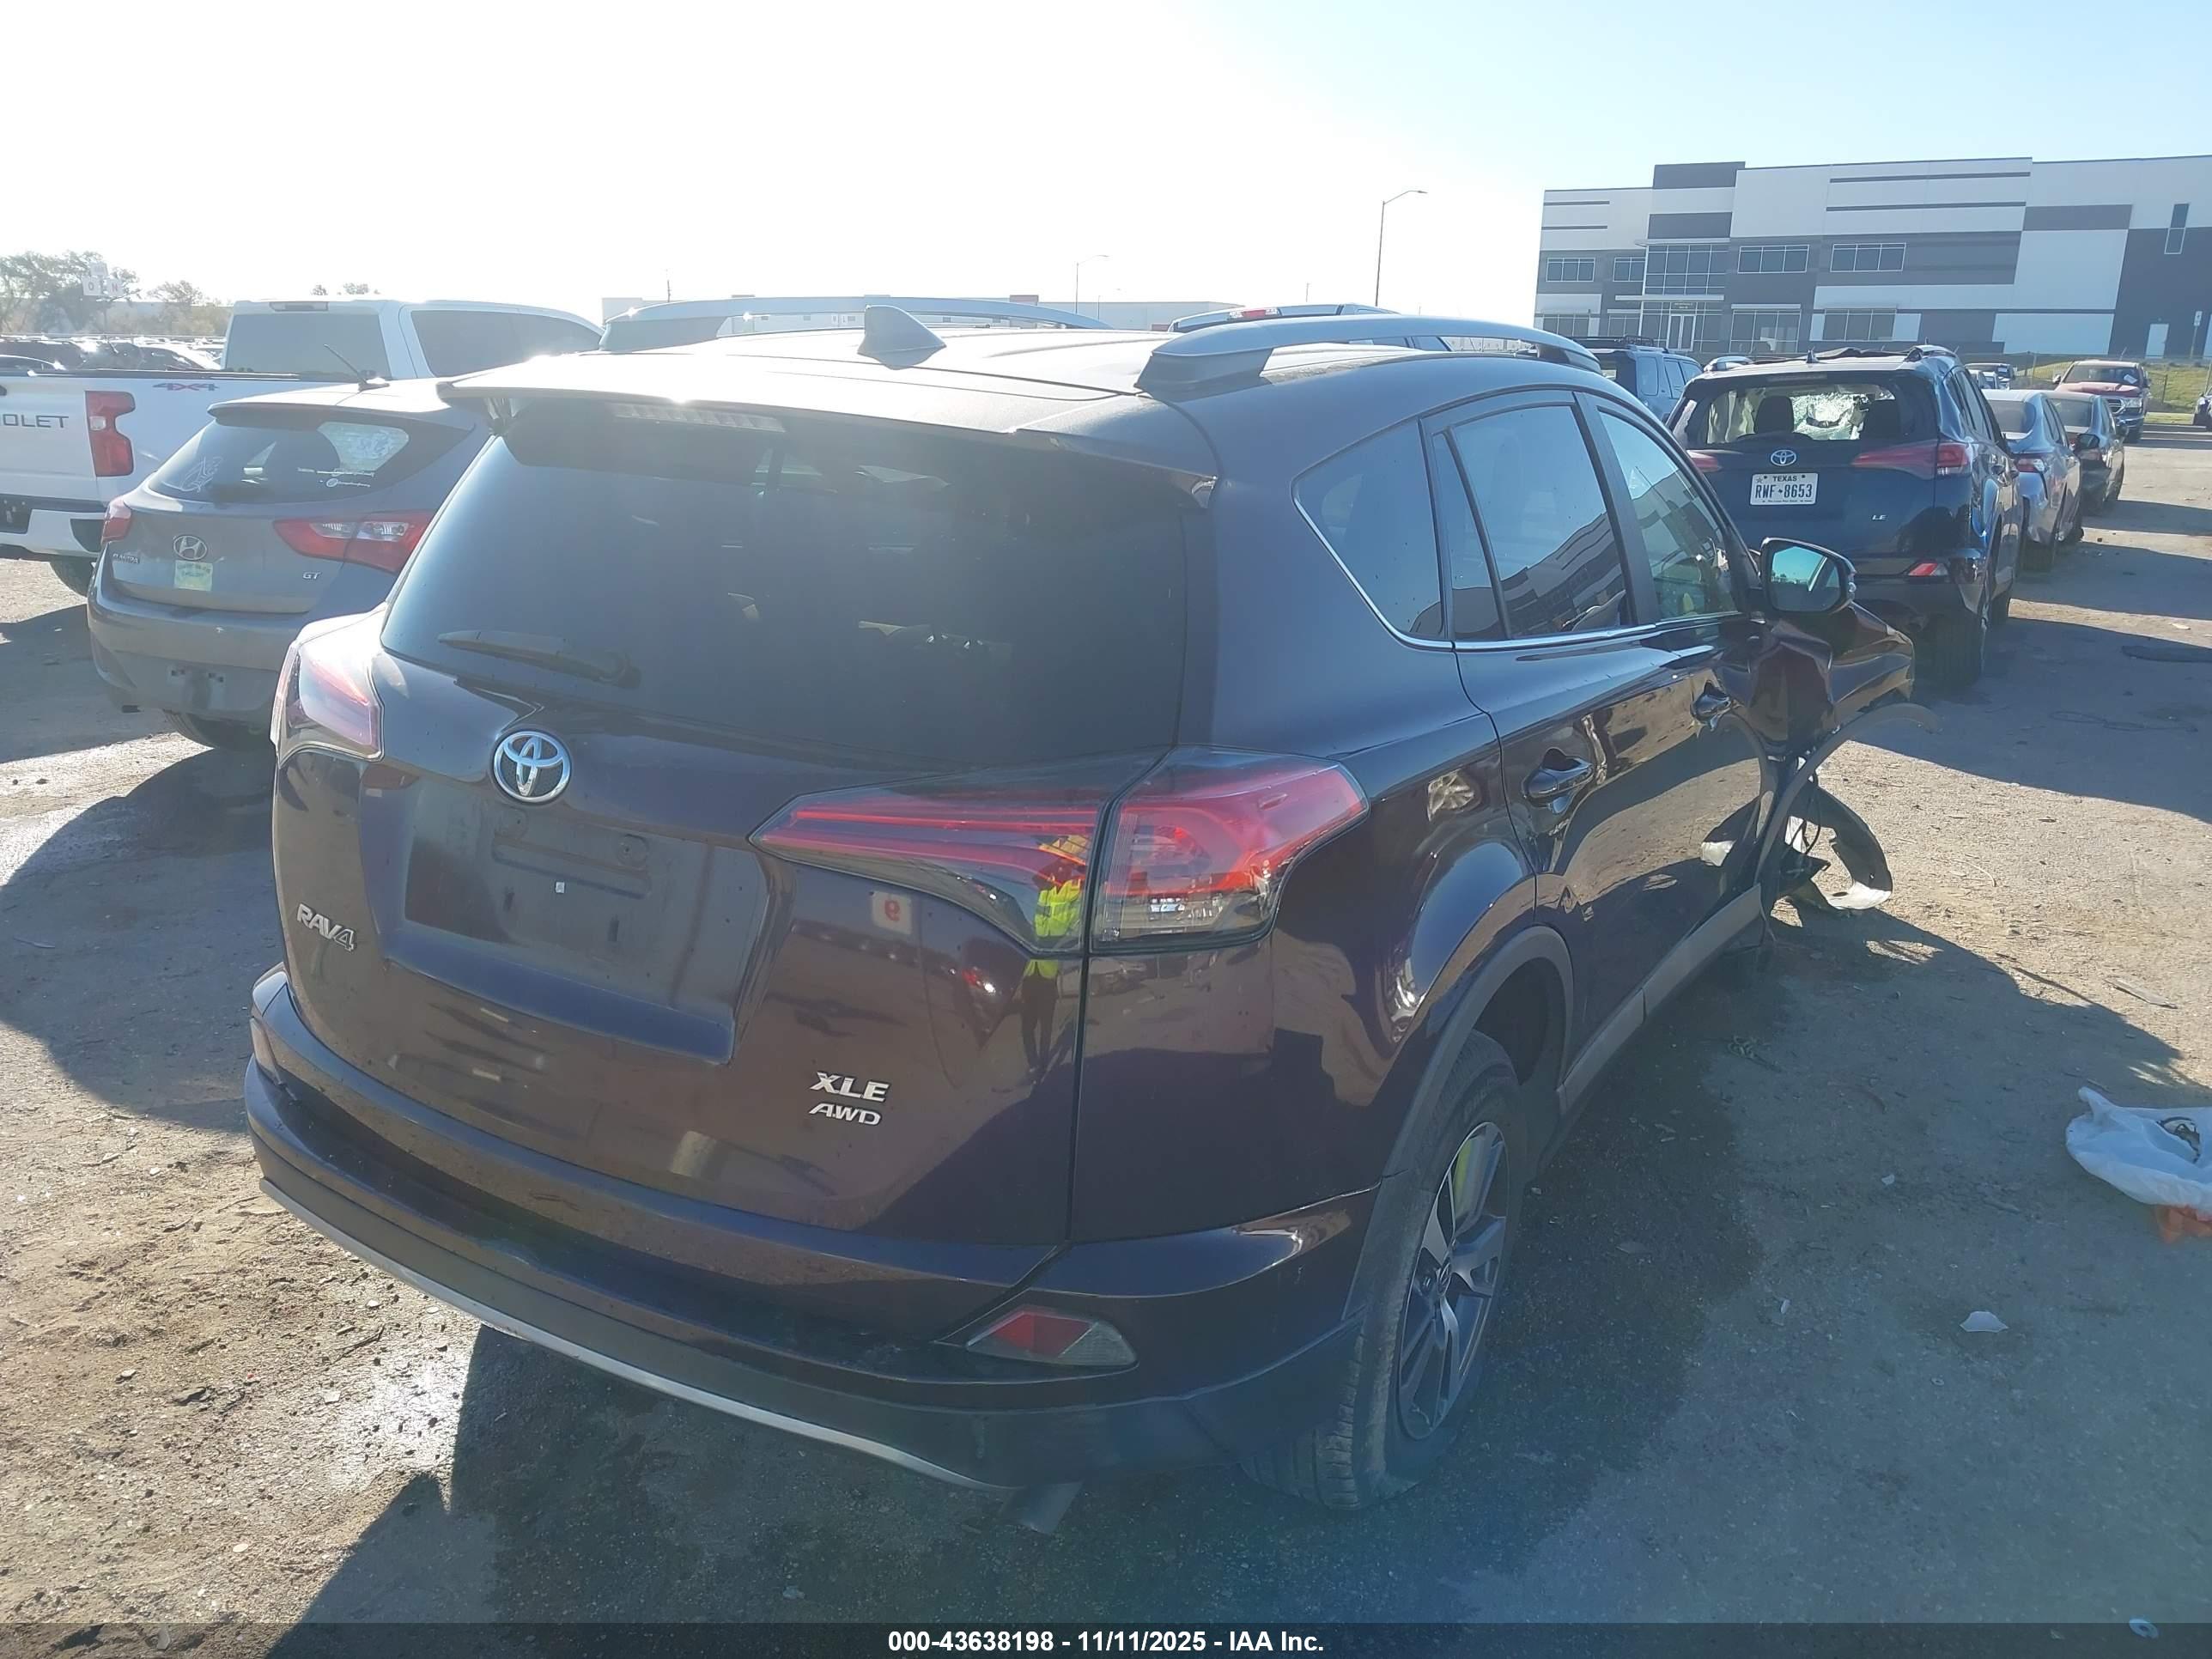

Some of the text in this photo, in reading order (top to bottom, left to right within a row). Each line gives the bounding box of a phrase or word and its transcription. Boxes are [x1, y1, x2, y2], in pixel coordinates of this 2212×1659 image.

[302, 571, 322, 580] GT
[296, 902, 355, 952] RAV4
[809, 1071, 890, 1103] XLE
[808, 1103, 882, 1126] AWD
